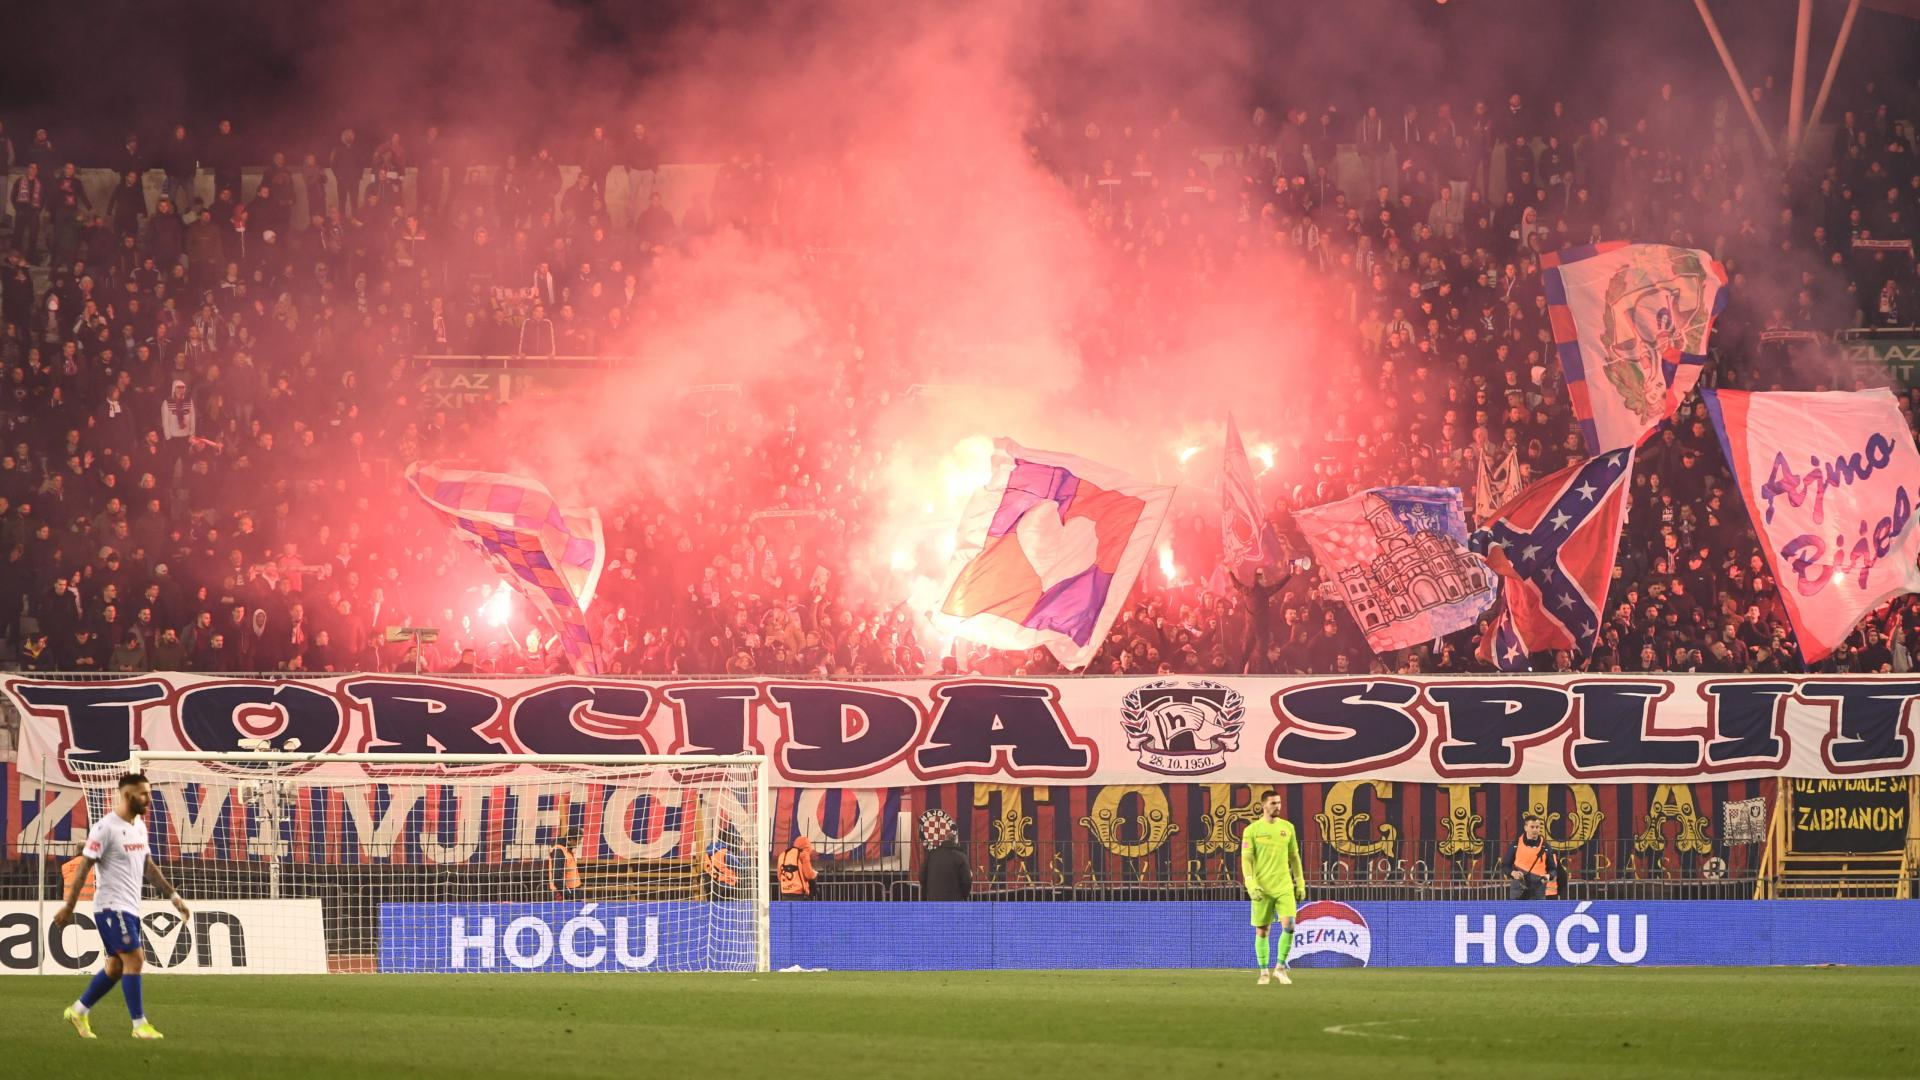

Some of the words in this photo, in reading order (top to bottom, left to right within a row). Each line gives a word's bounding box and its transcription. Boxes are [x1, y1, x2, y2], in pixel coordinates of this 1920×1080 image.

[1761, 432, 1895, 525] Ajmo
[6, 677, 1098, 782] TORCIDA
[1265, 673, 1920, 778] SPLIT
[973, 780, 1713, 858] TORCIDA
[1797, 807, 1905, 832] ZABRANOM
[450, 902, 659, 969] HOĆU
[1294, 928, 1360, 948] RE/MAX
[1454, 900, 1648, 964] HOĆU
